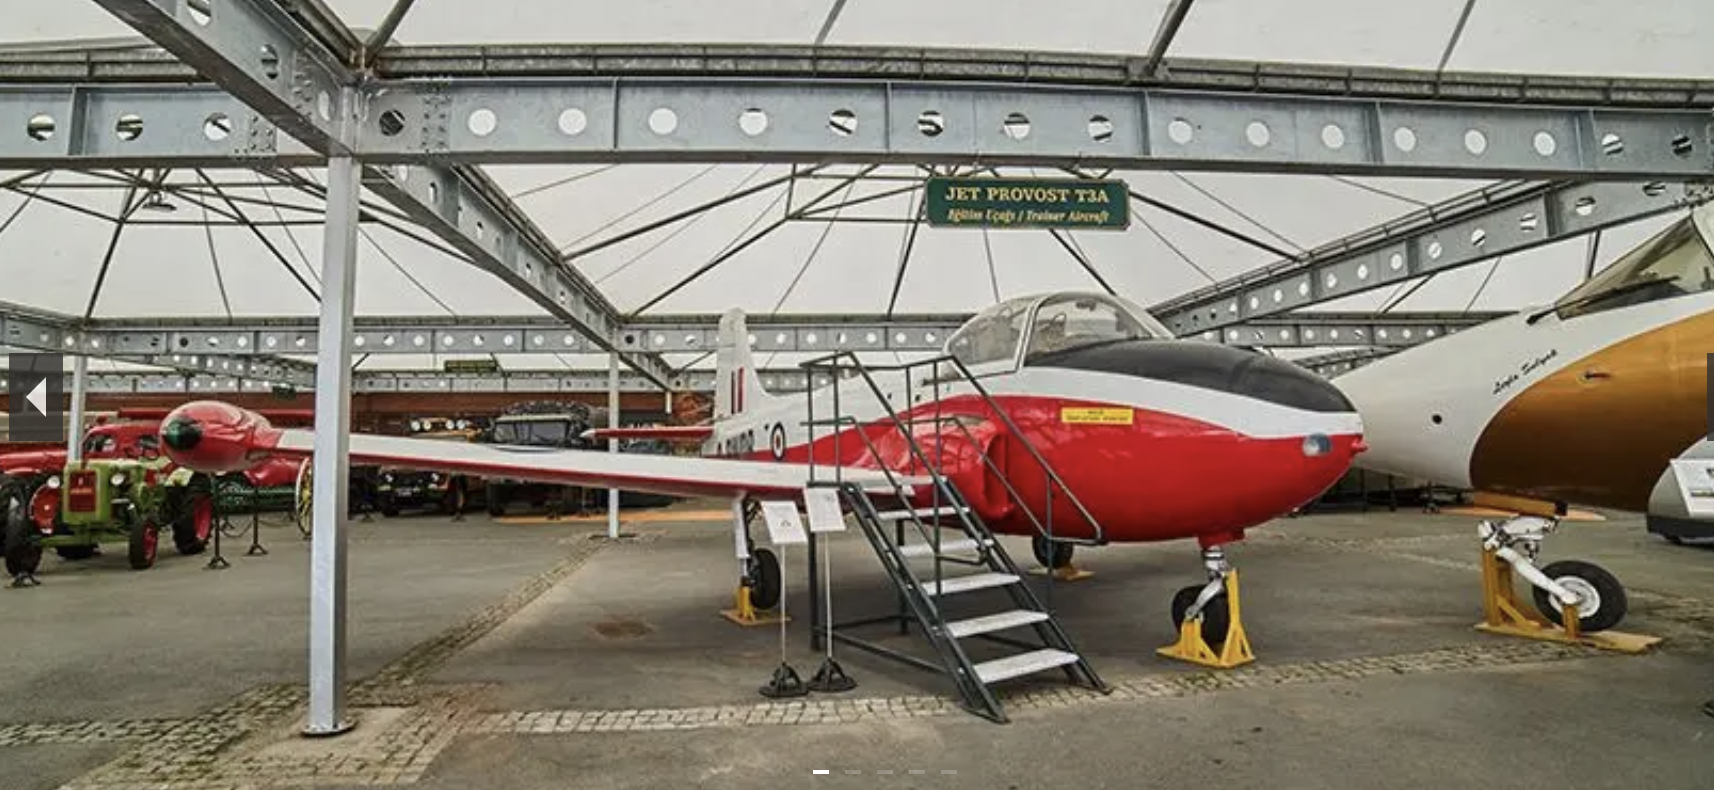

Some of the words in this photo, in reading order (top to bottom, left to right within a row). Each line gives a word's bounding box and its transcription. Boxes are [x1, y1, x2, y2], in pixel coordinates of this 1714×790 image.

[945, 187, 981, 201] JET
[987, 187, 1070, 202] PROVOST
[1074, 189, 1109, 203] T3A
[1026, 210, 1066, 222] Trainer
[1068, 210, 1110, 224] Aircraft
